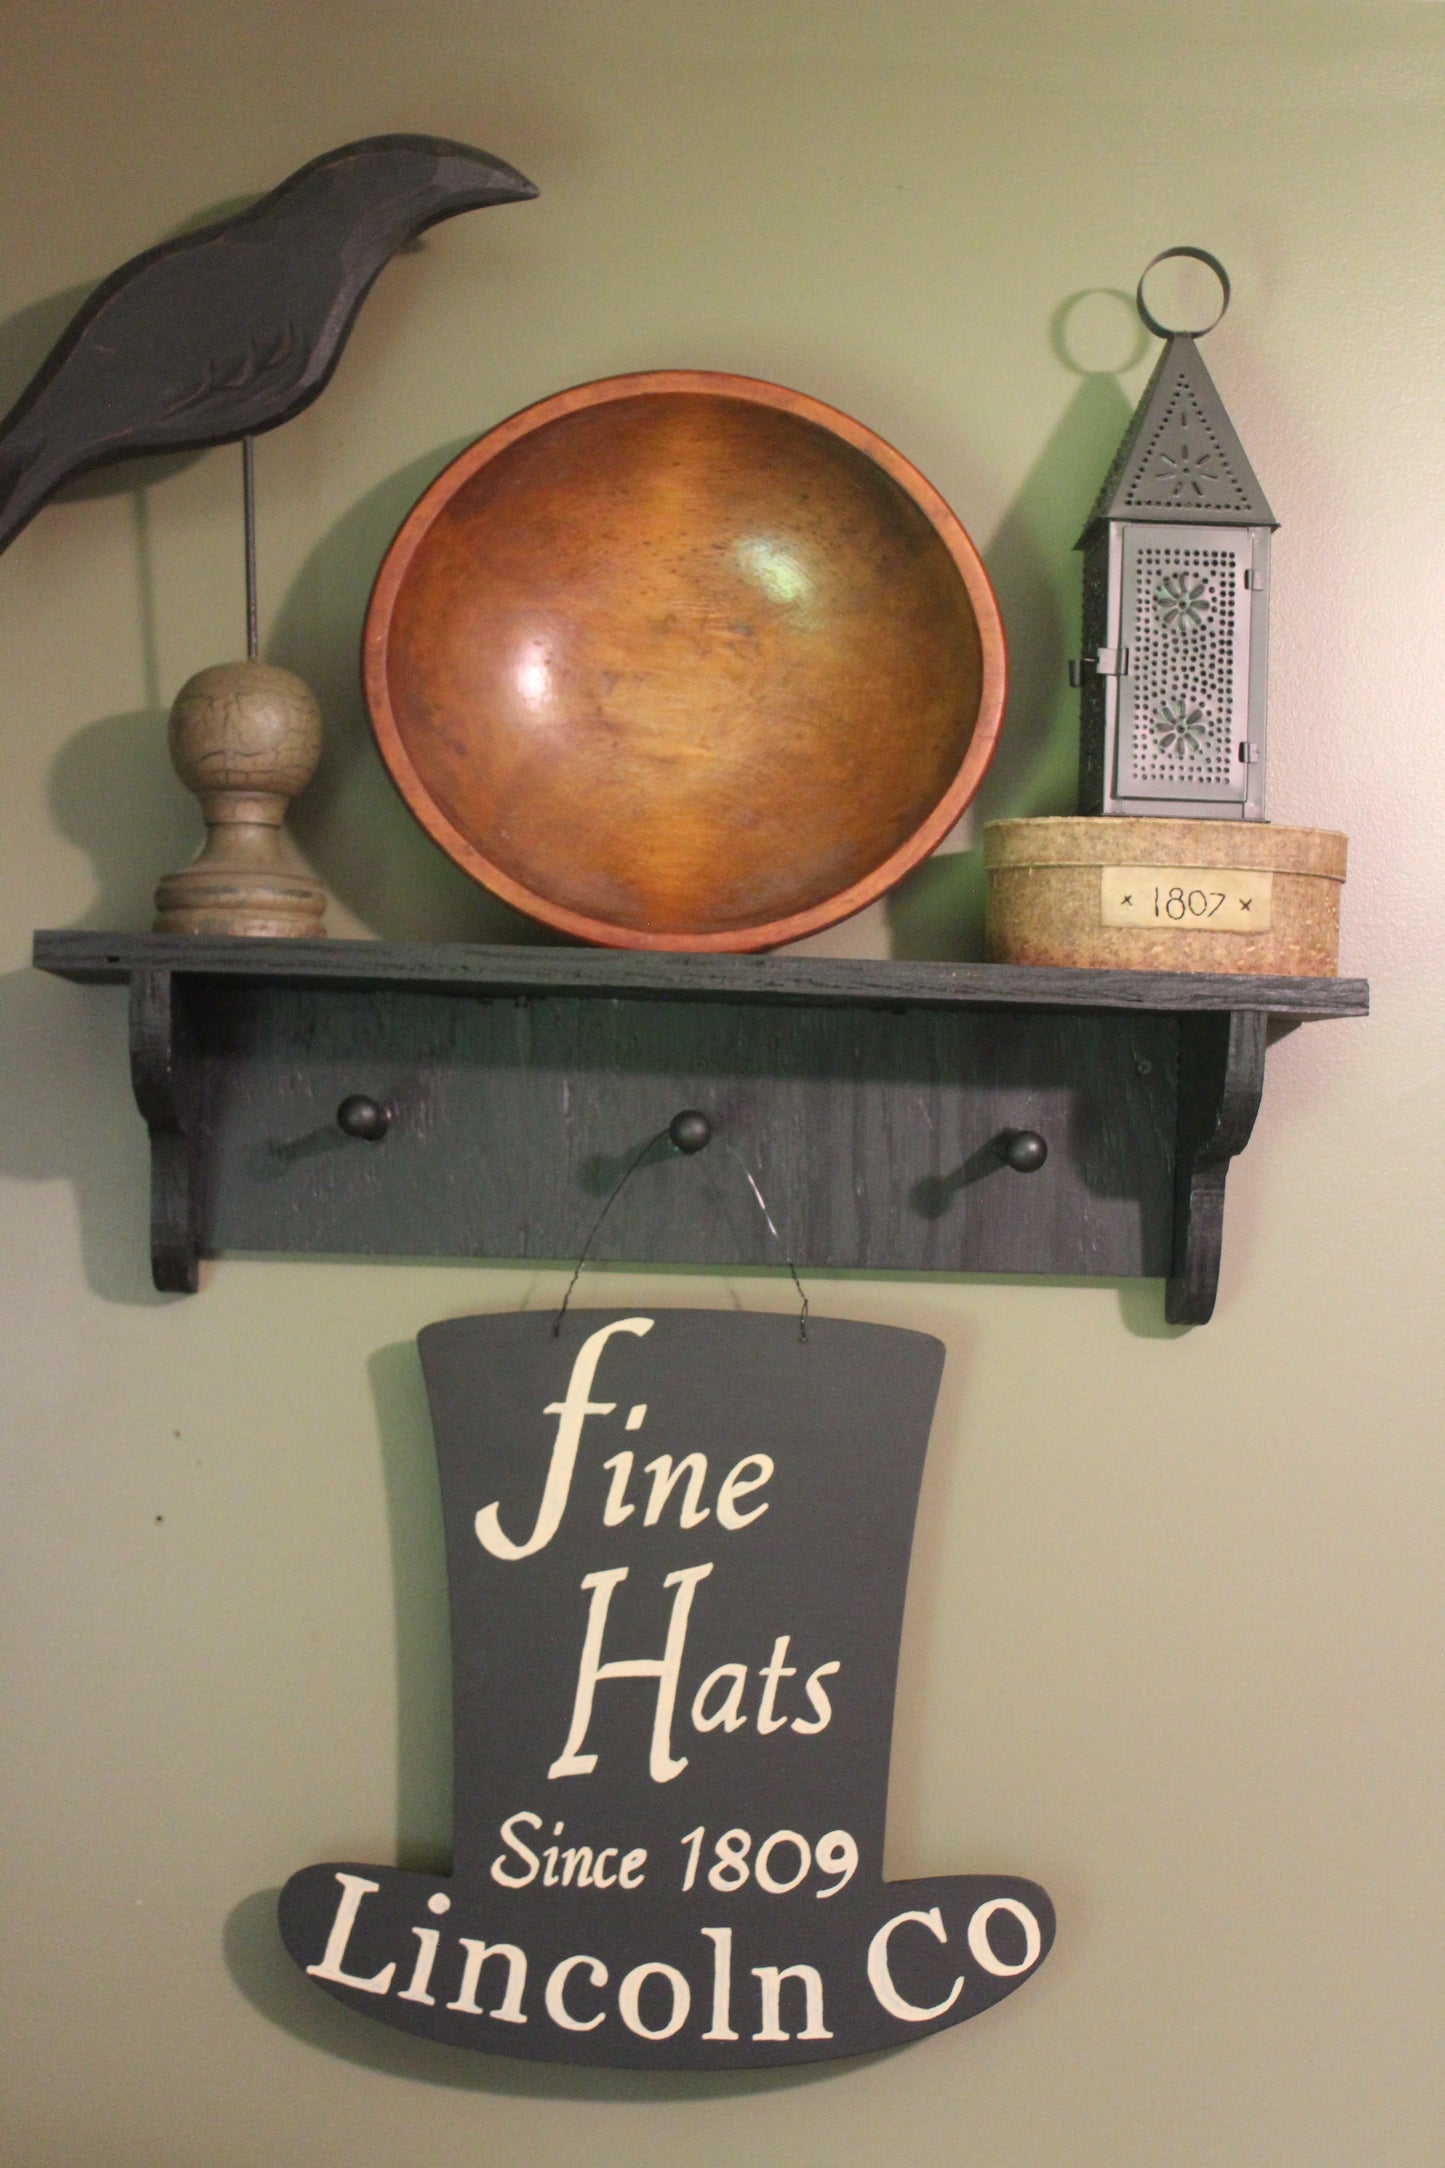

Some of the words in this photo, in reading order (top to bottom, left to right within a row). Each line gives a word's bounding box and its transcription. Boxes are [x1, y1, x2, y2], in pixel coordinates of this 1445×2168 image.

[1153, 886, 1227, 921] 1807
[547, 1562, 841, 1783] Hats
[490, 1811, 648, 1889] Since
[680, 1825, 859, 1899] 1809
[306, 1872, 834, 2041] Lincoln
[867, 1897, 1041, 2022] Co
